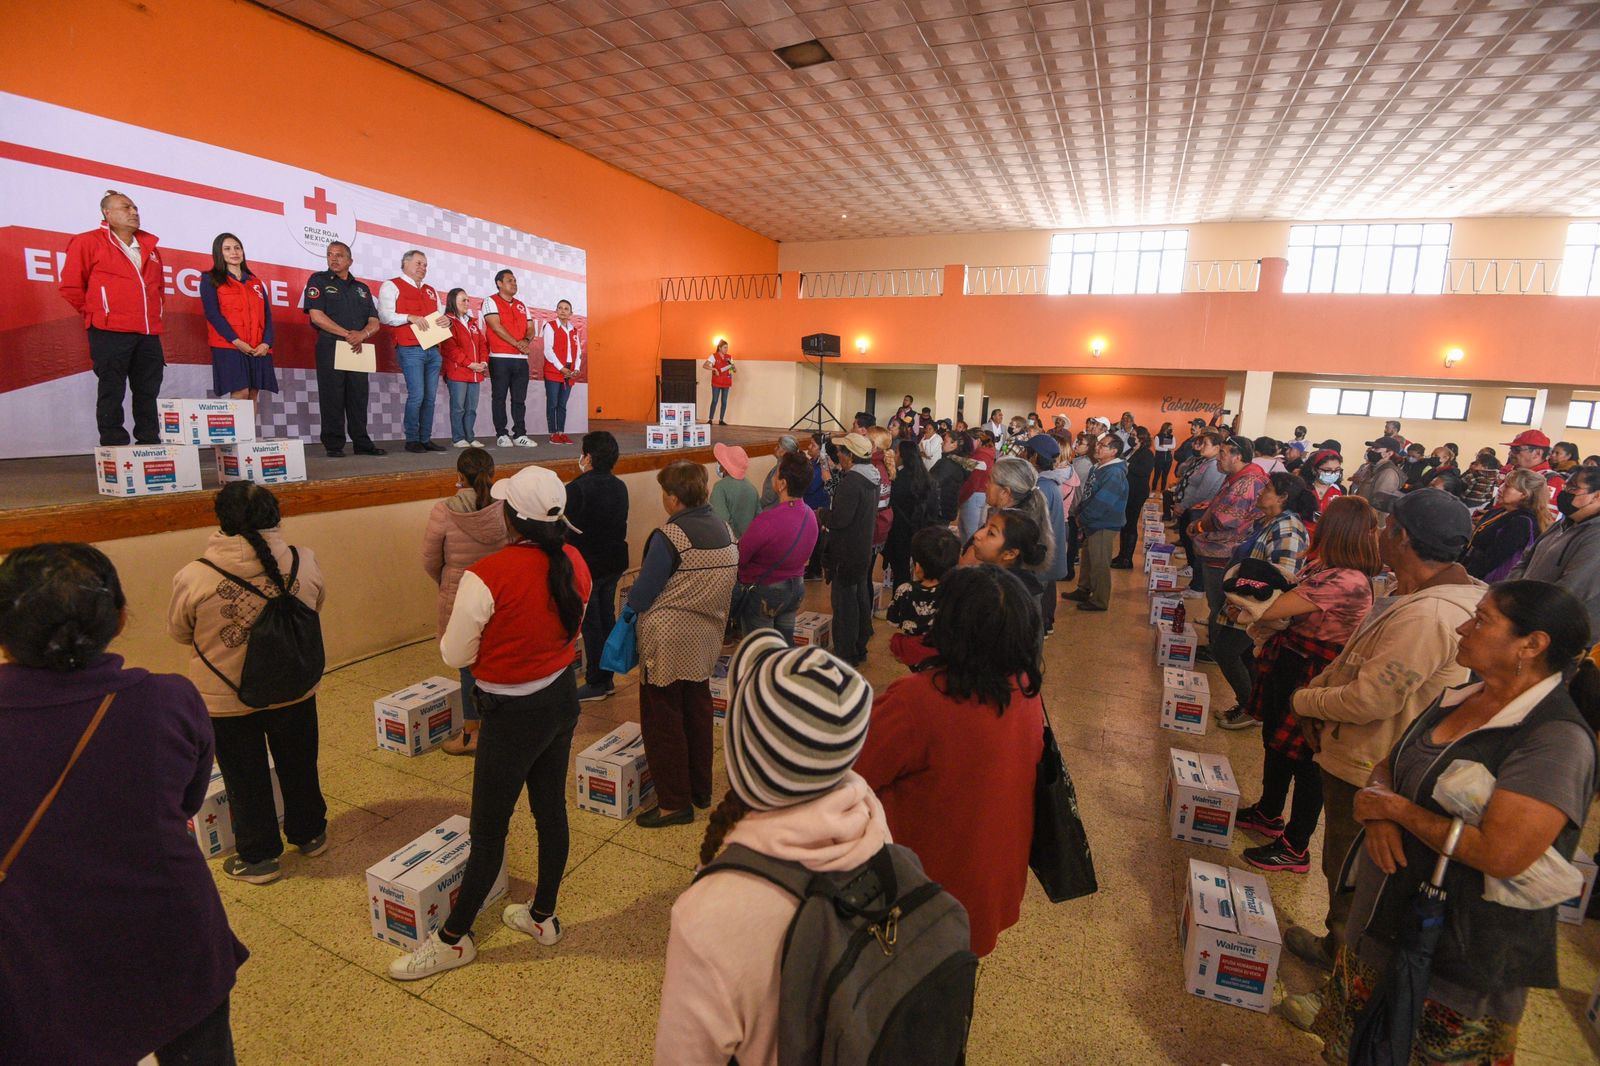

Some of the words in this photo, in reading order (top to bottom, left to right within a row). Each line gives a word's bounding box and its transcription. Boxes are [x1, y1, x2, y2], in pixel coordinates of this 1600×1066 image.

[304, 226, 321, 235] CRUZ
[322, 230, 339, 239] ROJA
[1041, 390, 1088, 409] Damas
[1161, 396, 1224, 413] Caballeros
[199, 403, 228, 411] Walmart
[132, 449, 167, 458] Walmart
[252, 445, 280, 453] Walmart
[420, 699, 447, 716] Walmart
[585, 765, 607, 776] Walmart
[1192, 794, 1222, 807] Walmart
[436, 838, 471, 864] almart
[378, 884, 405, 902] Walmart
[1216, 939, 1257, 955] Walmart
